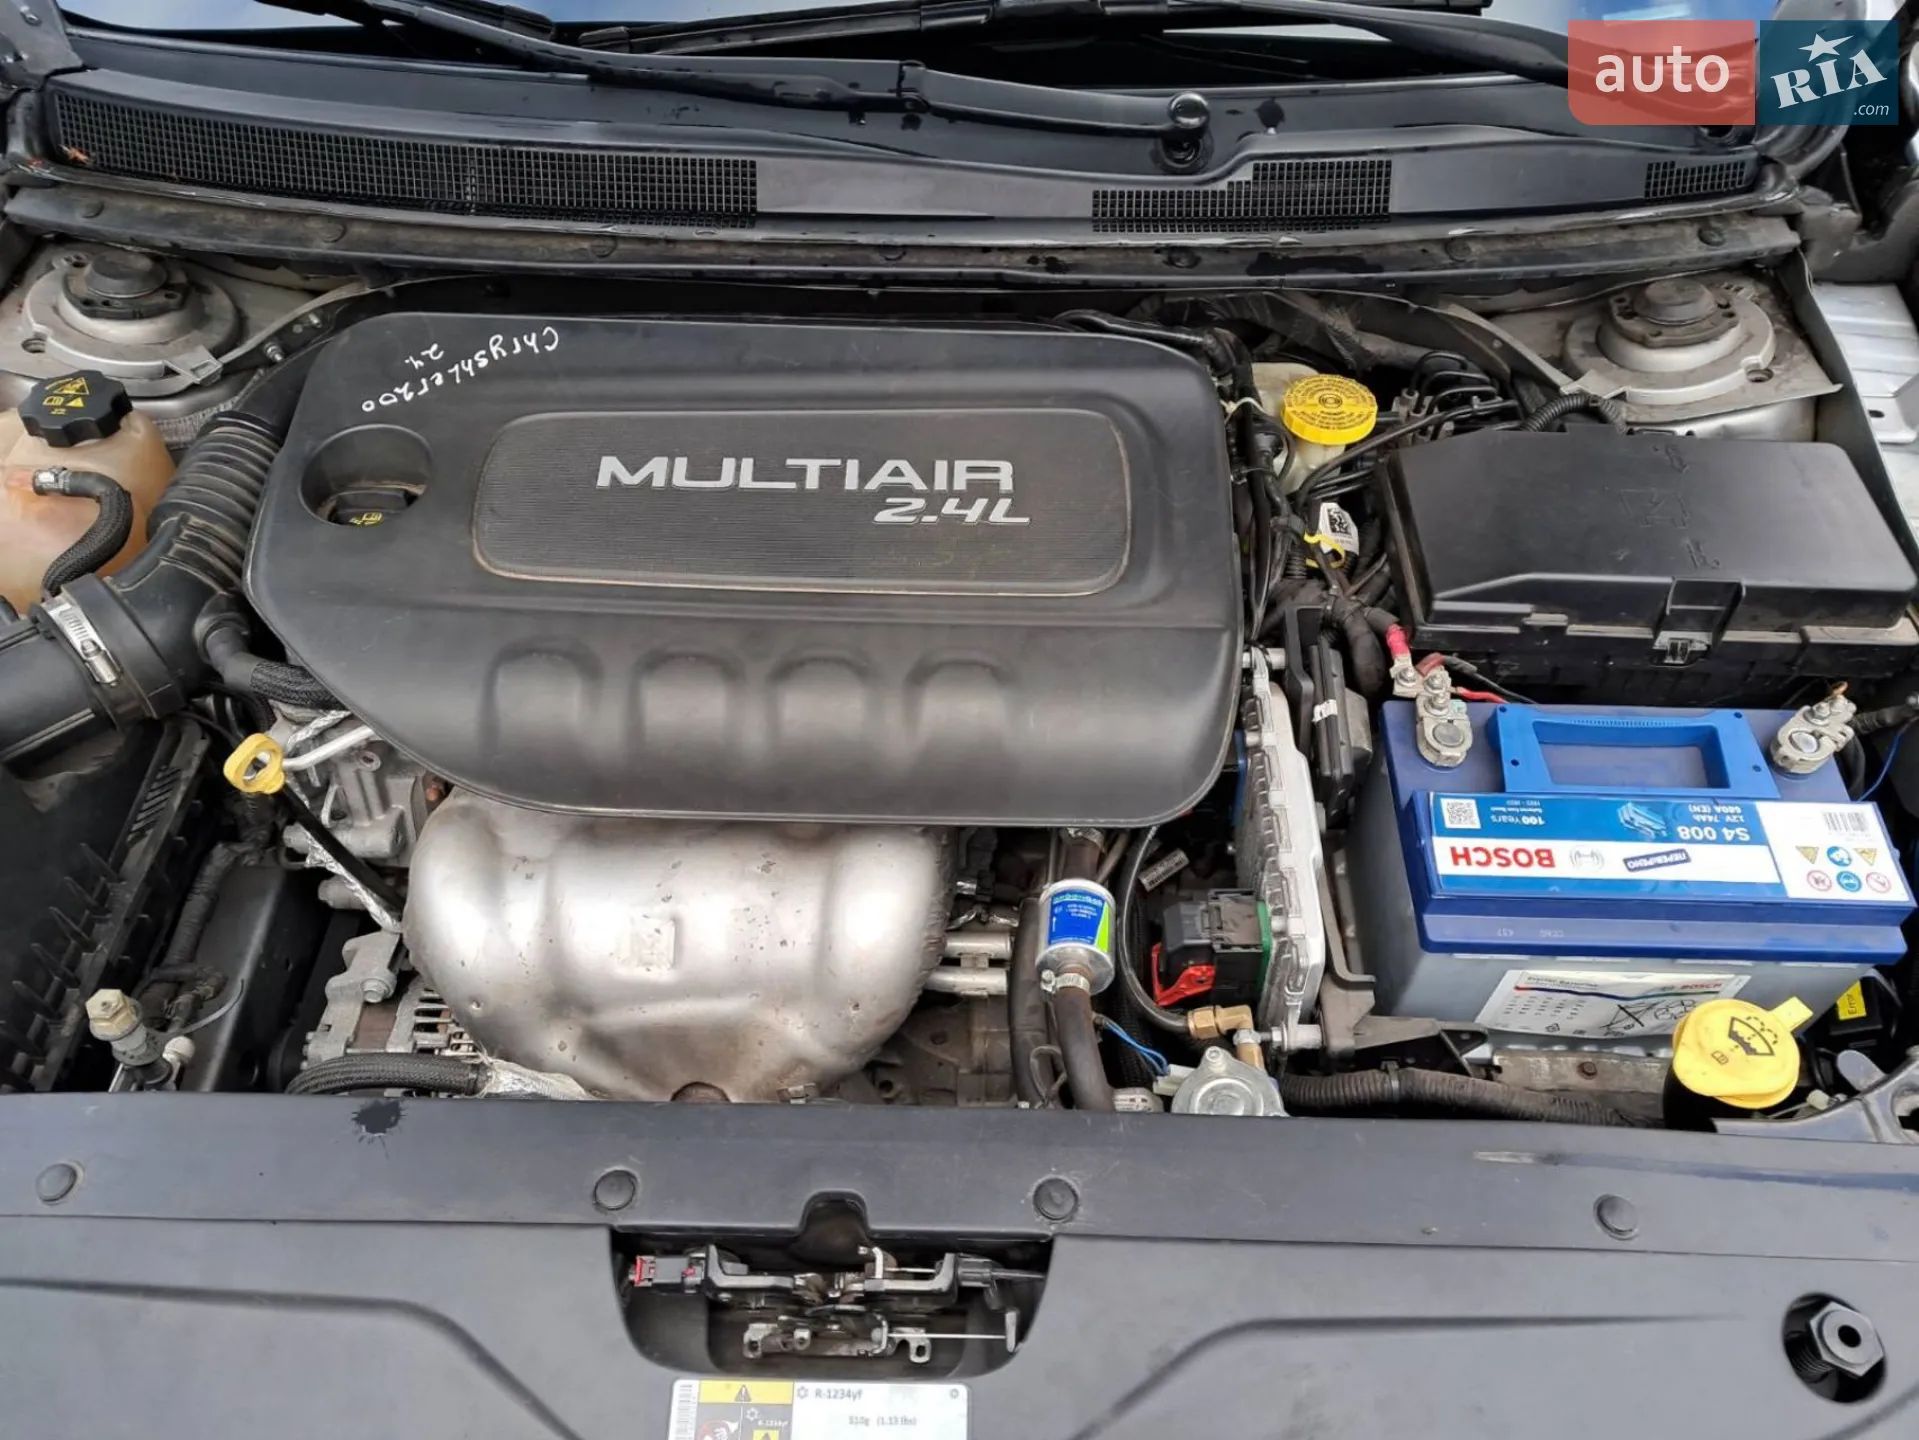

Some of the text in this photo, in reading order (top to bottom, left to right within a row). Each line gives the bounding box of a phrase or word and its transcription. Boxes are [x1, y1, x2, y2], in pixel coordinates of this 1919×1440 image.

[596, 455, 1014, 492] MULTIAIR
[872, 497, 1031, 525] 2.4L
[1490, 815, 1546, 826] 100 Years
[1692, 814, 1745, 823] 12V 74Ah
[1676, 825, 1751, 842] S4 008
[1449, 845, 1556, 868] BOSCH
[815, 1388, 863, 1401] R-1234yf
